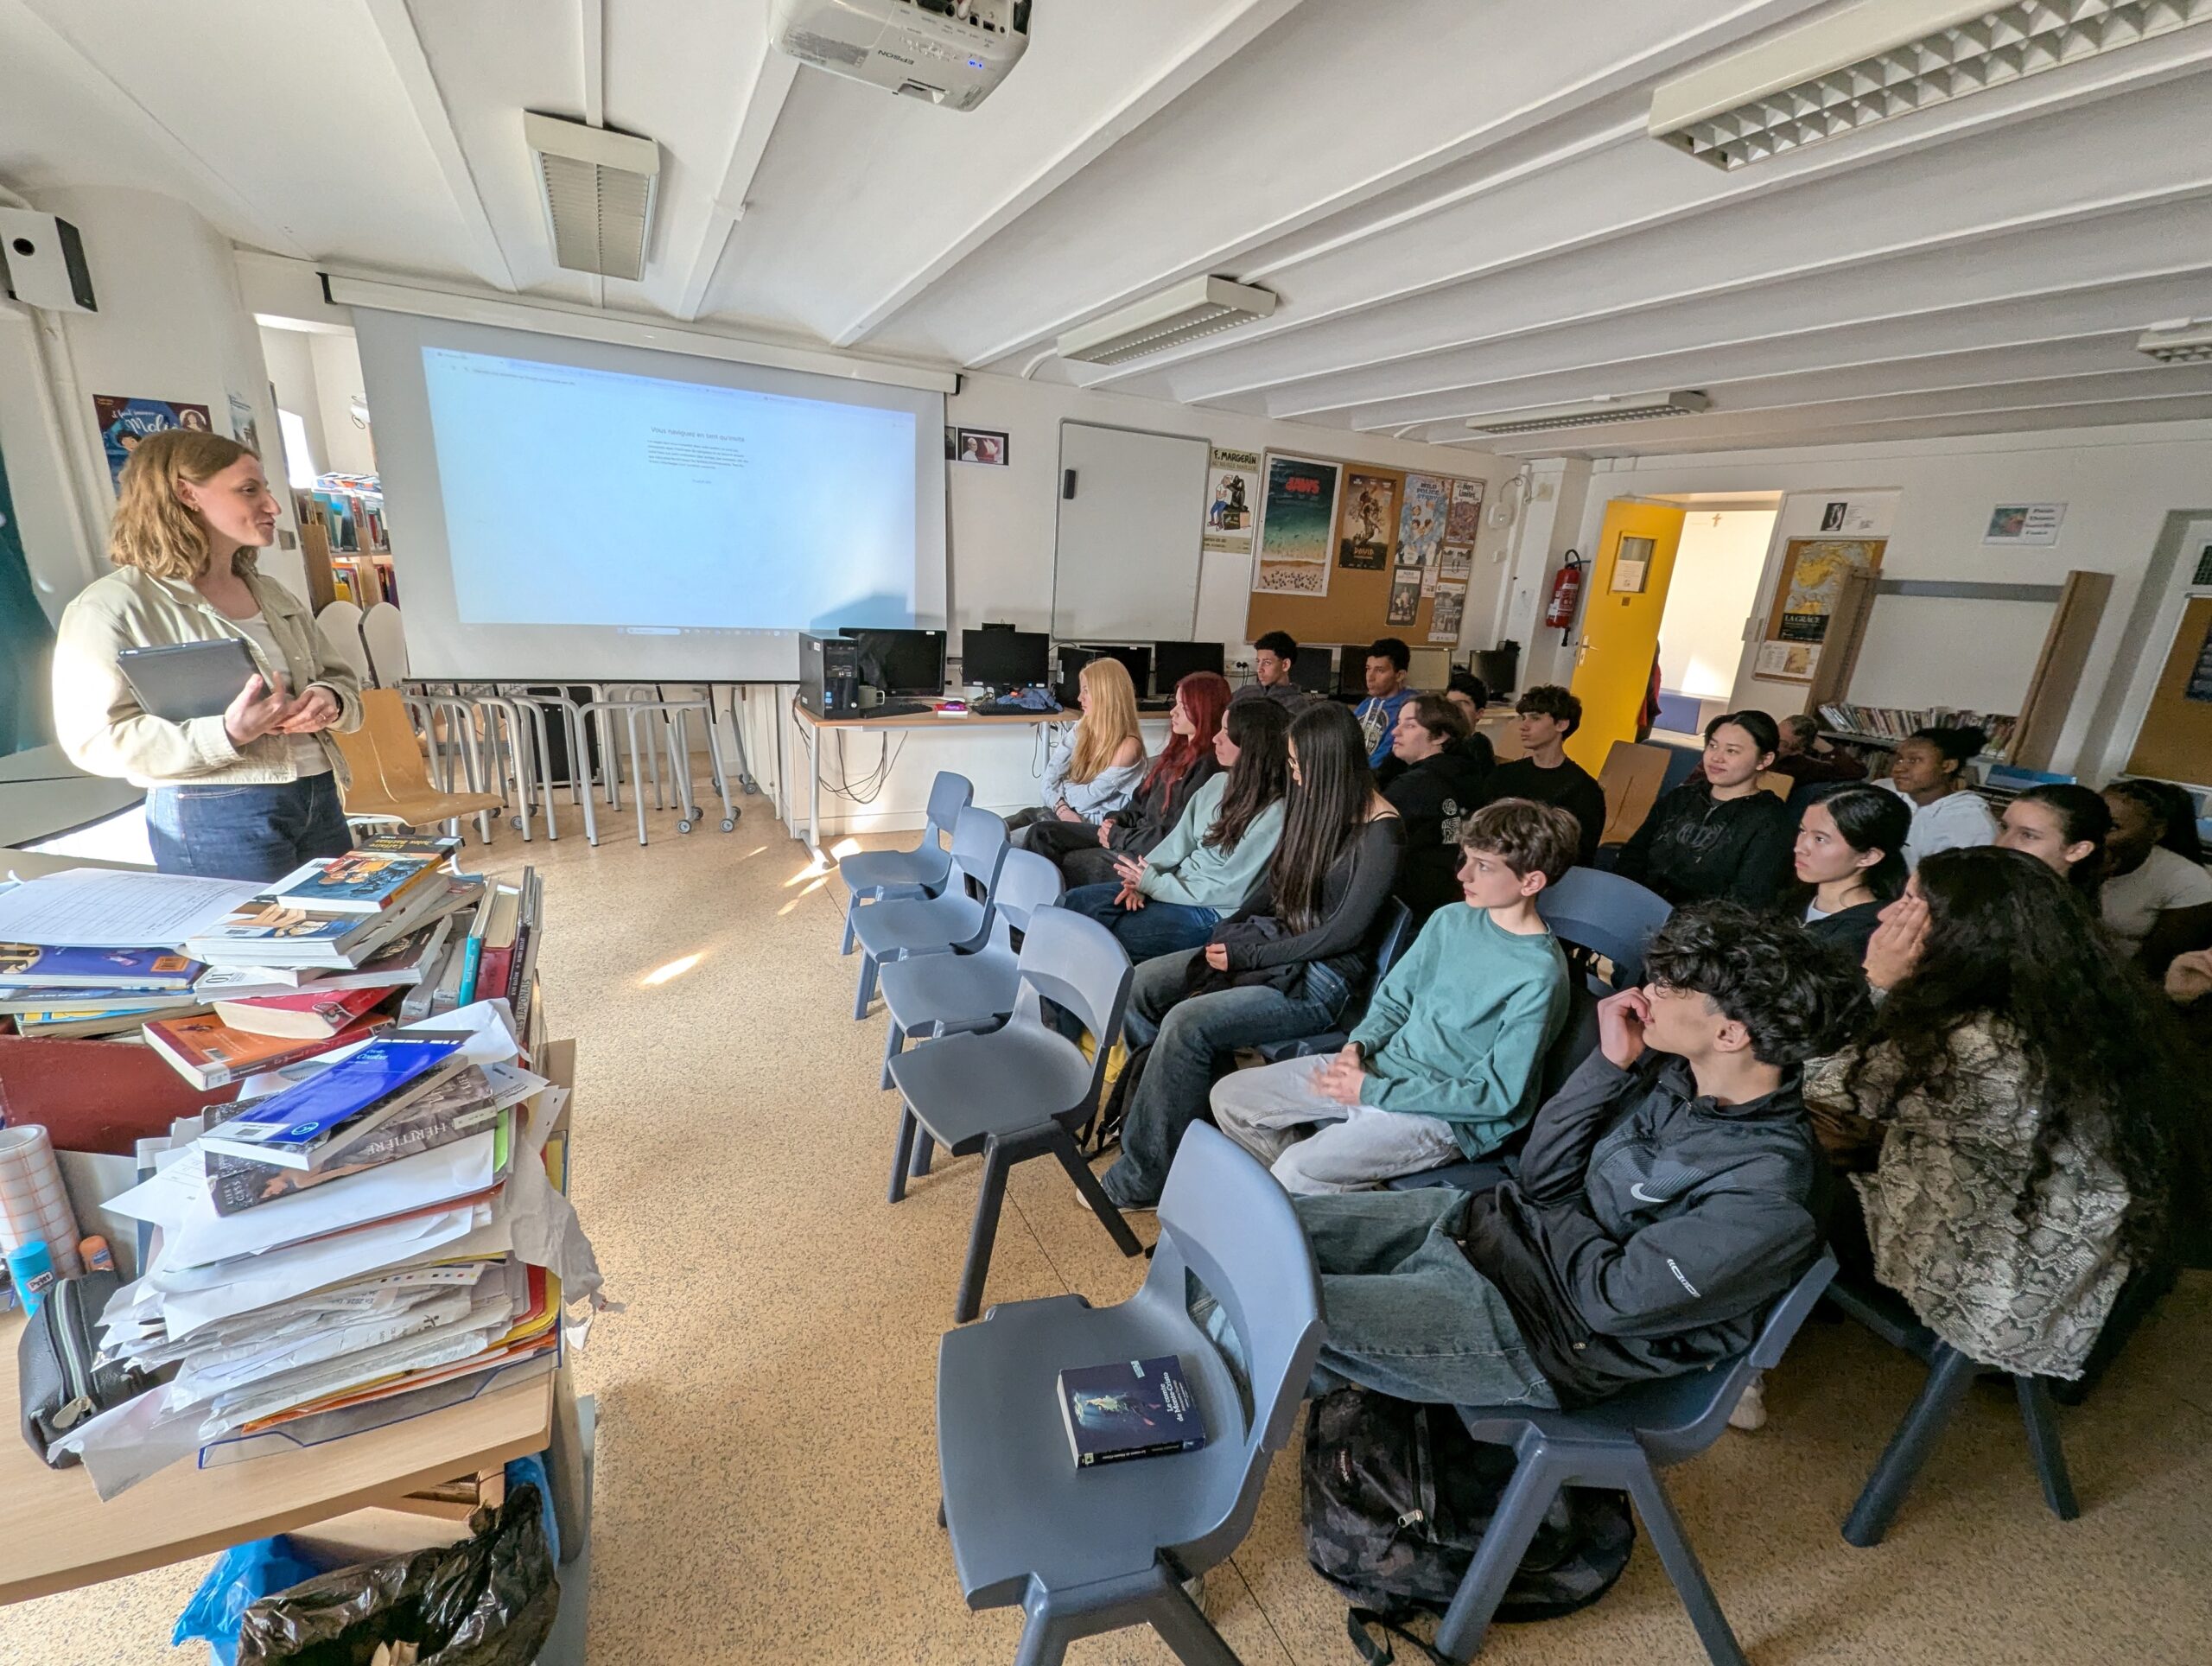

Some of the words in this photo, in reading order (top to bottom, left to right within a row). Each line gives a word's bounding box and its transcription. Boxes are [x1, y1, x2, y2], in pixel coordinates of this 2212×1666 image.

[878, 49, 914, 66] EPSON
[124, 414, 179, 435] Moli
[651, 426, 666, 435] Vous
[668, 429, 696, 438] naviguez
[1285, 476, 1320, 494] JAWS
[1417, 487, 1440, 496] POLICE
[515, 979, 531, 1018] JAPONAIS
[30, 1273, 52, 1288] Pritt
[1160, 1383, 1173, 1402] comte
[1162, 1371, 1182, 1414] Monte-Cristo
[1166, 1402, 1174, 1413] Le
[1176, 1413, 1184, 1421] de
